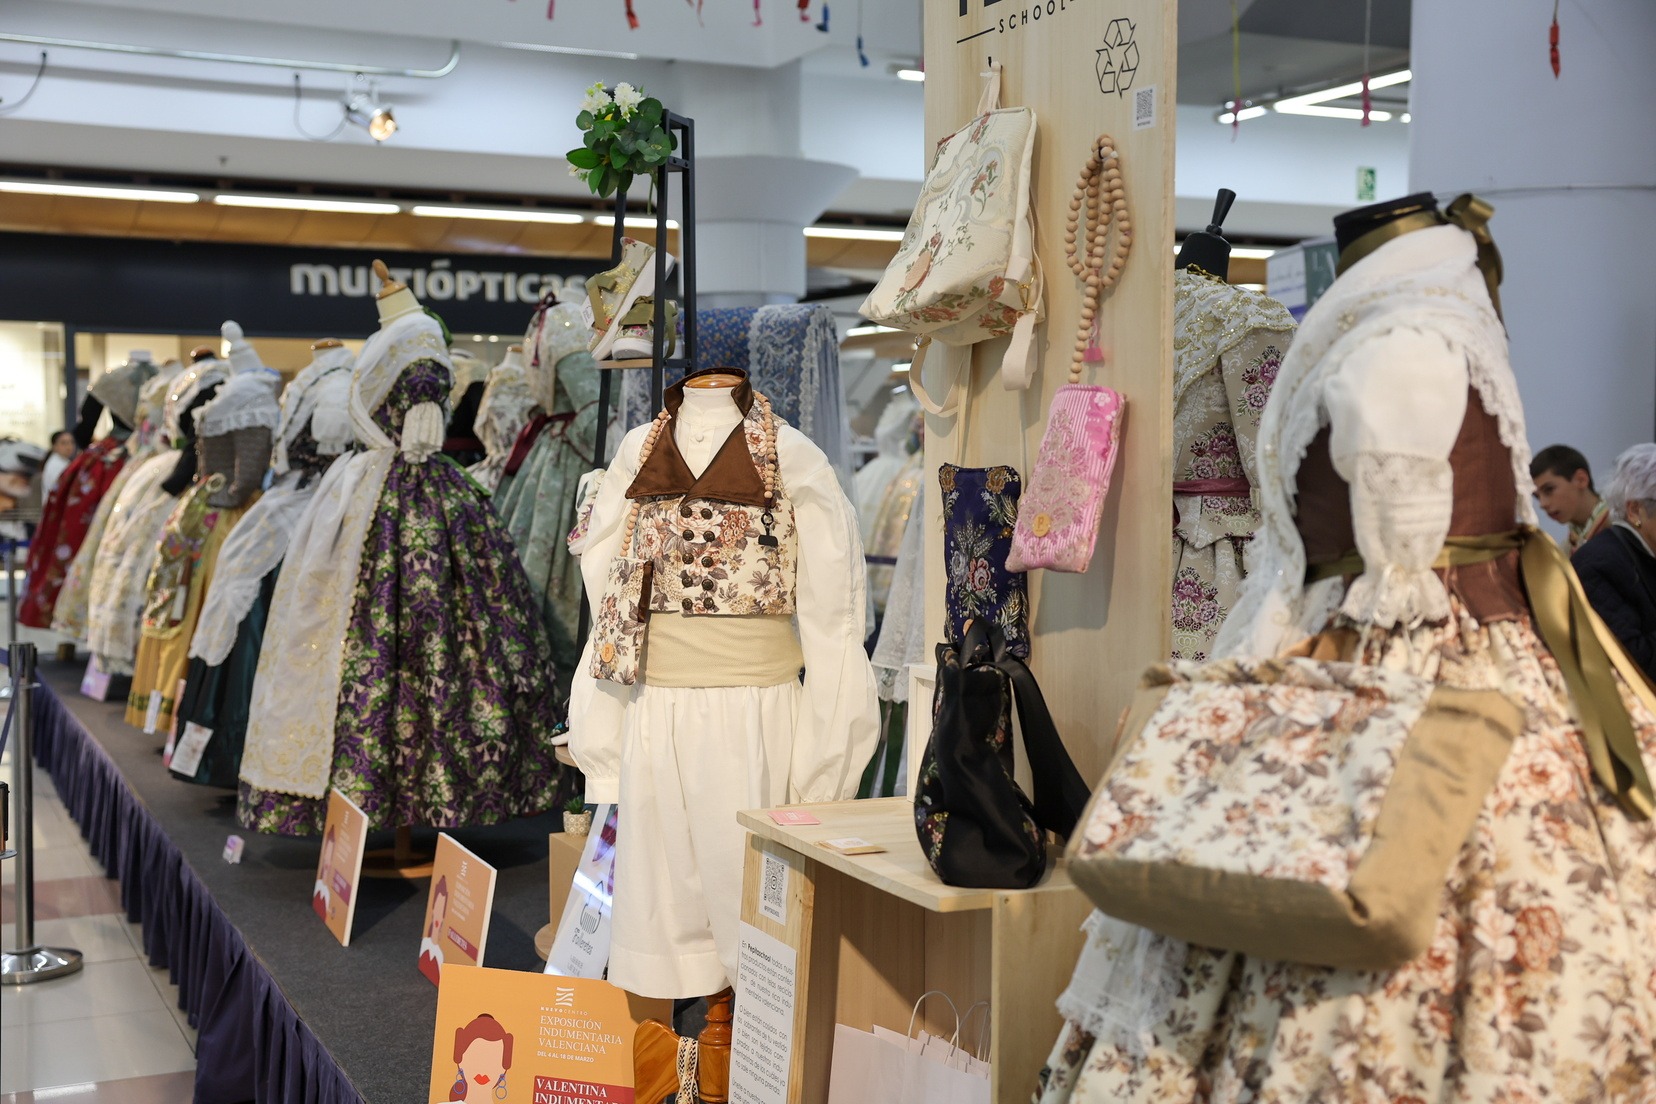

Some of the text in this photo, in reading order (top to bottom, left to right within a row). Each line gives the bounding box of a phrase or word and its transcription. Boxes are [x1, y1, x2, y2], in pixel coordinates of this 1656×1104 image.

[999, 0, 1066, 34] SCHOOL
[748, 943, 770, 963] Pepitaschool
[749, 956, 766, 972] productos
[540, 1006, 588, 1016] NUEVOCENTRO
[540, 1015, 603, 1031] EXPOSICIÓN
[539, 1026, 624, 1045] INDUMENTARIA
[779, 1031, 787, 1041] con
[538, 1037, 607, 1055] VALENCIANA
[536, 1050, 548, 1058] DEL
[575, 1055, 595, 1063] MARZO
[536, 1078, 608, 1098] VALENTINA
[534, 1092, 623, 1104] INDUMEN
